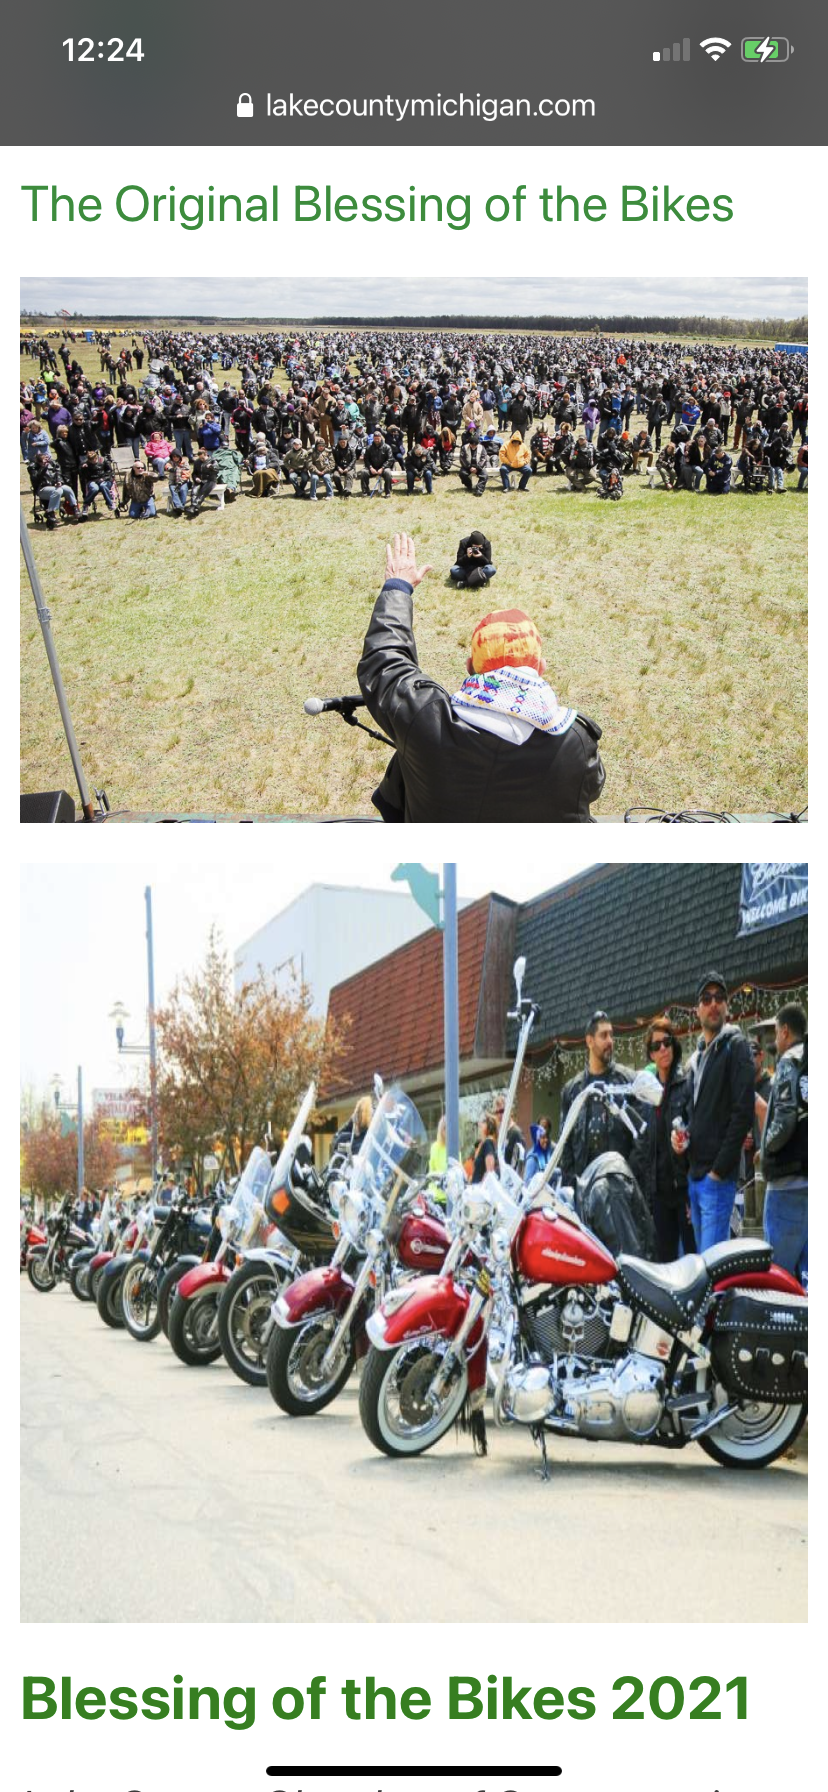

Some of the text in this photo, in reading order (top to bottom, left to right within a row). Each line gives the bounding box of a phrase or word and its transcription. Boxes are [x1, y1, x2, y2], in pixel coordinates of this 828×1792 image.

[63, 38, 144, 61] 12:24
[268, 93, 595, 121] lakecountymichigan.com
[21, 185, 733, 230] The Original Blessing of the Bikes
[741, 895, 788, 926] WELCOME
[23, 1675, 746, 1730] Blessing of the Bikes 2021
